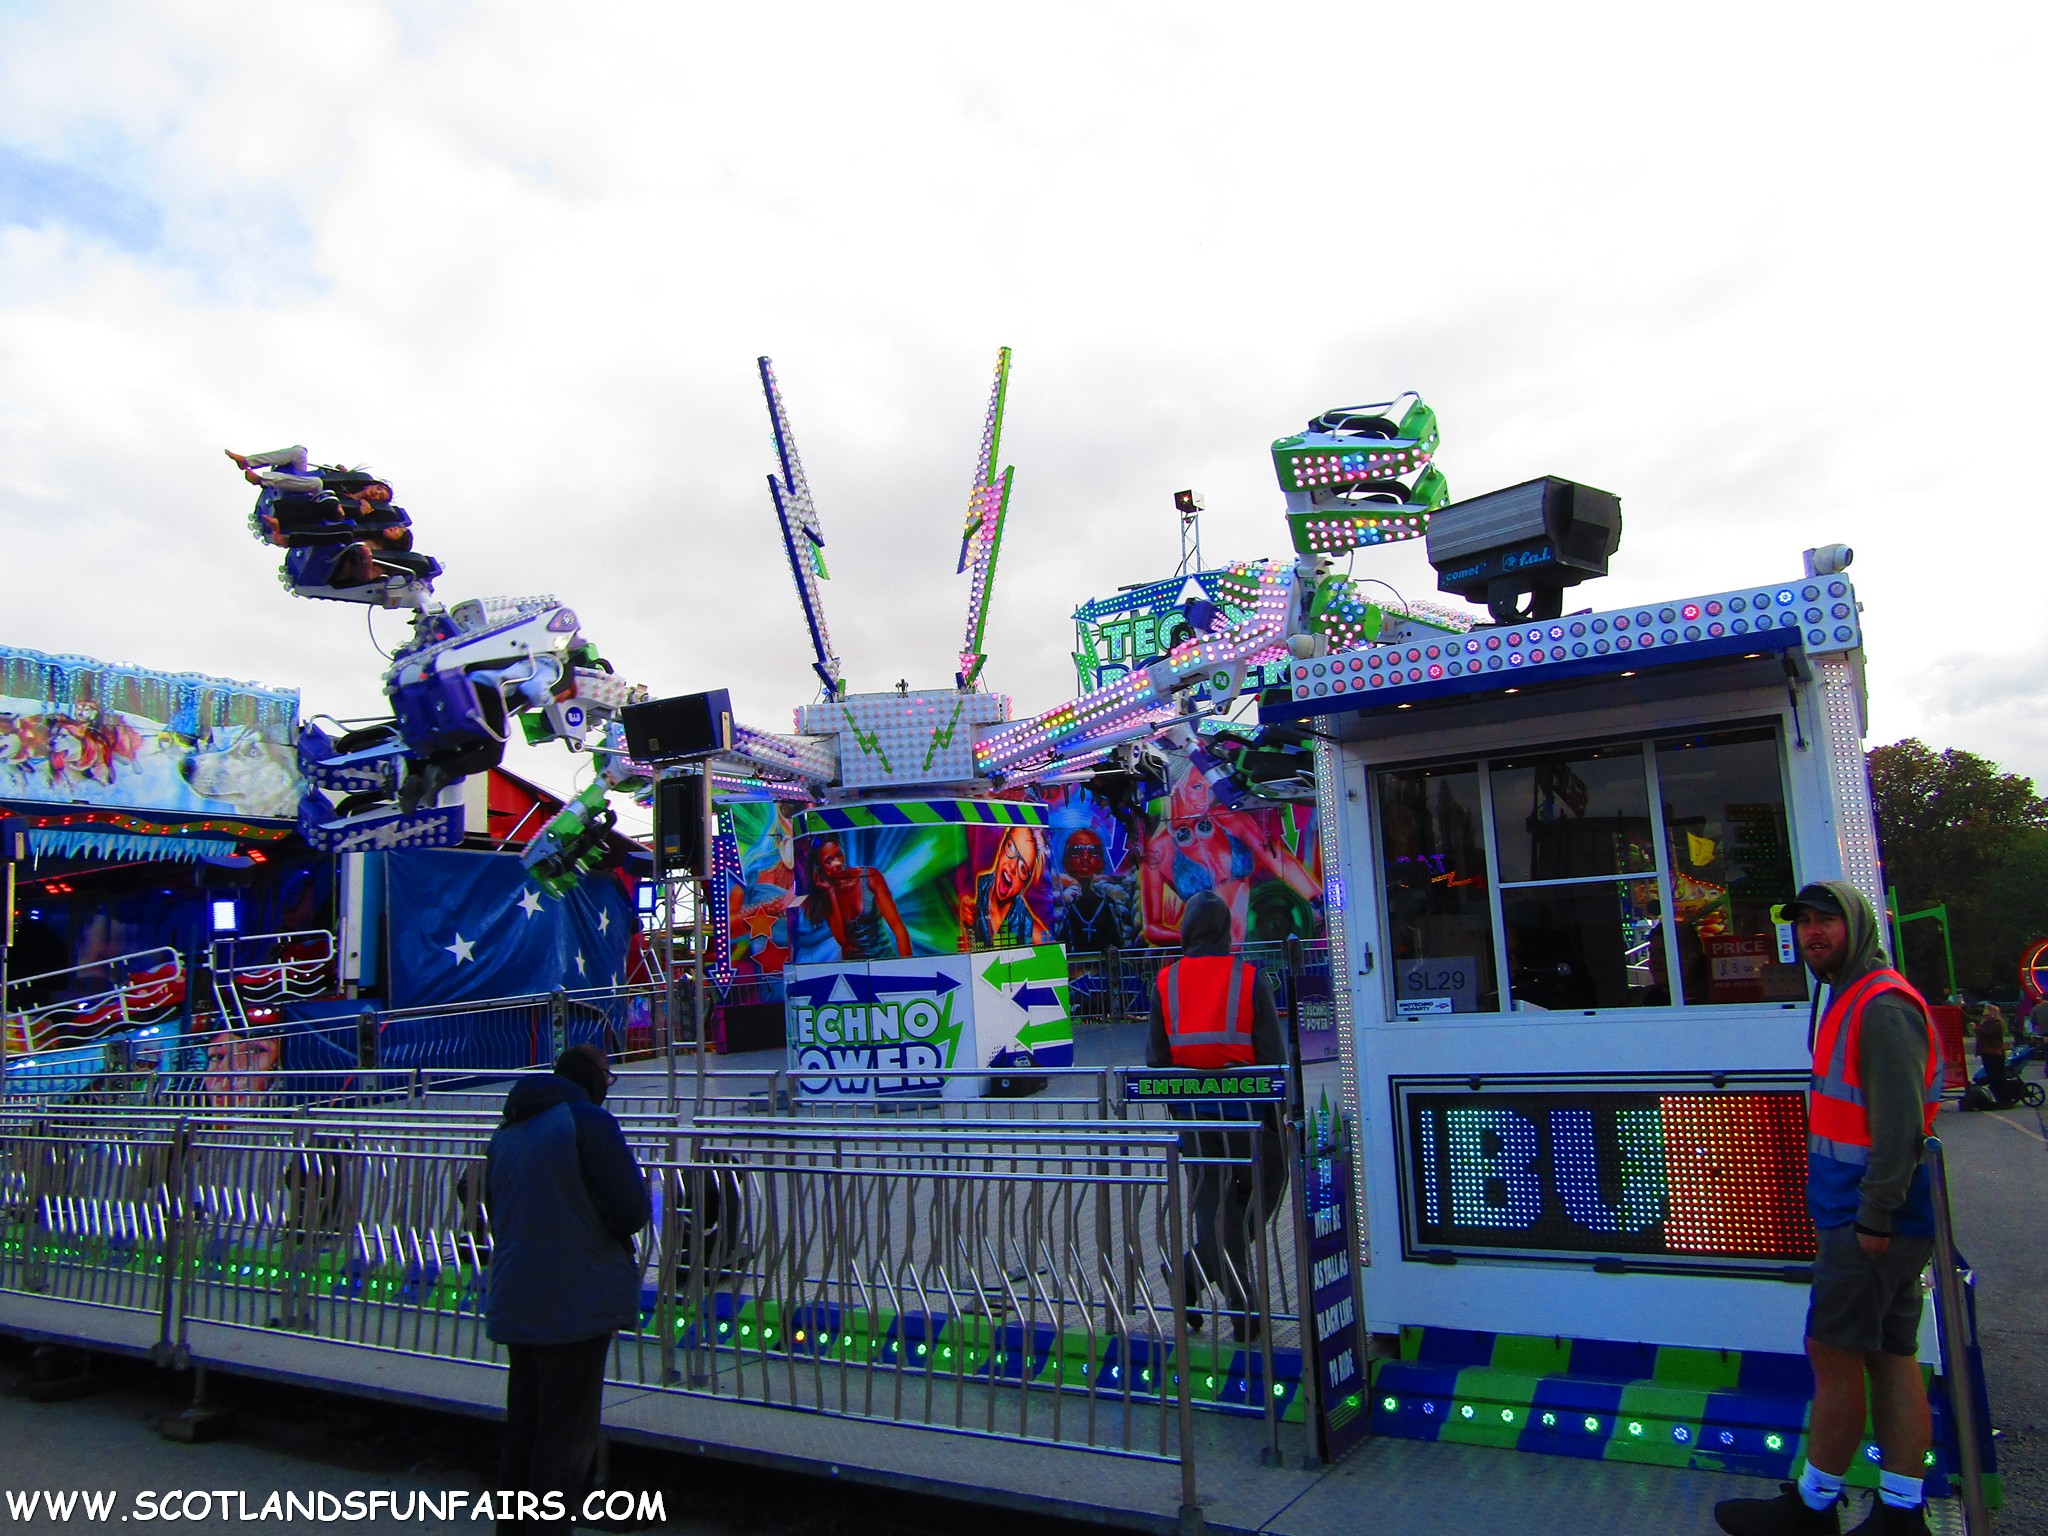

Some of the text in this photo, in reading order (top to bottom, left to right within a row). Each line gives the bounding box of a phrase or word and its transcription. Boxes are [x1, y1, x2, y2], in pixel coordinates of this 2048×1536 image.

[1445, 563, 1481, 581] comet
[1711, 940, 1766, 955] PRICE
[1408, 970, 1466, 991] SL29
[797, 1001, 941, 1046] ECHNO
[798, 1042, 946, 1094] OWER
[1138, 1076, 1272, 1097] ENTRANCE
[1331, 1203, 1342, 1232] BE
[1313, 1260, 1324, 1291] AS
[1338, 1248, 1349, 1278] AS
[1316, 1303, 1341, 1342] BLACK
[1328, 1347, 1356, 1389] TO RIDE
